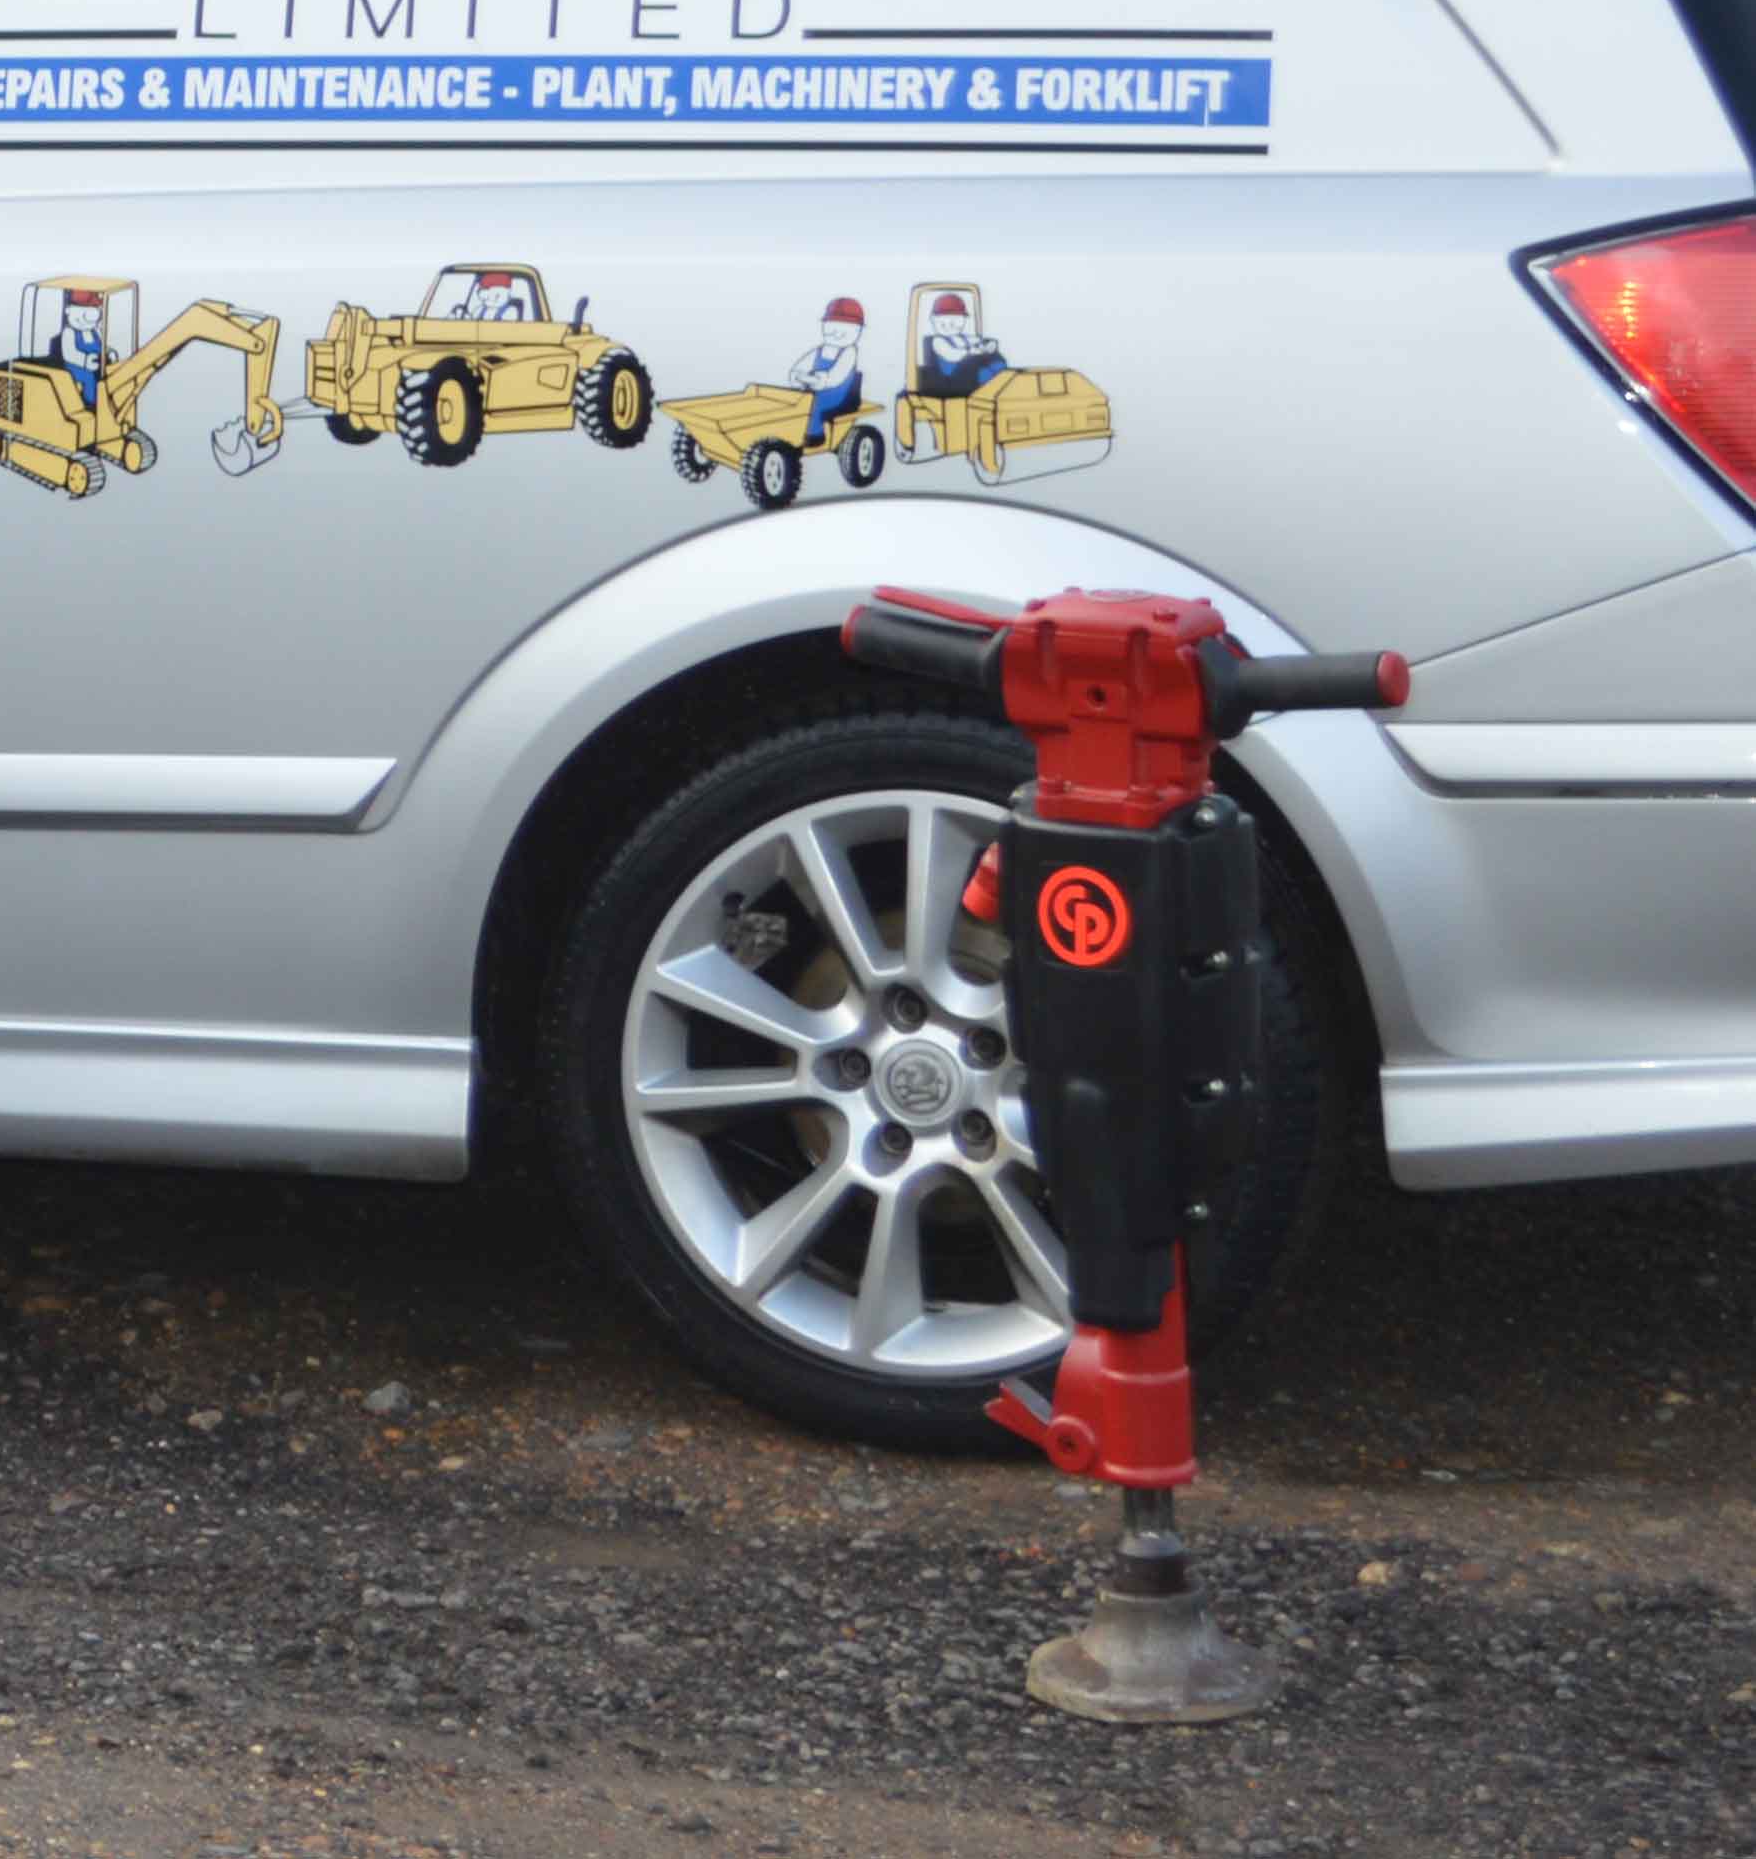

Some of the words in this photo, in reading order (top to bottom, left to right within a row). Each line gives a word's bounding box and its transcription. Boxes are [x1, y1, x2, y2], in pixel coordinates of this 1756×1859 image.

[138, 68, 171, 109] &
[184, 66, 492, 109] MAINTENANCE
[532, 66, 678, 116] PLANT,
[690, 67, 957, 110] MACHINERY
[966, 68, 1003, 110] &
[1015, 68, 1231, 113] FORKLIFT
